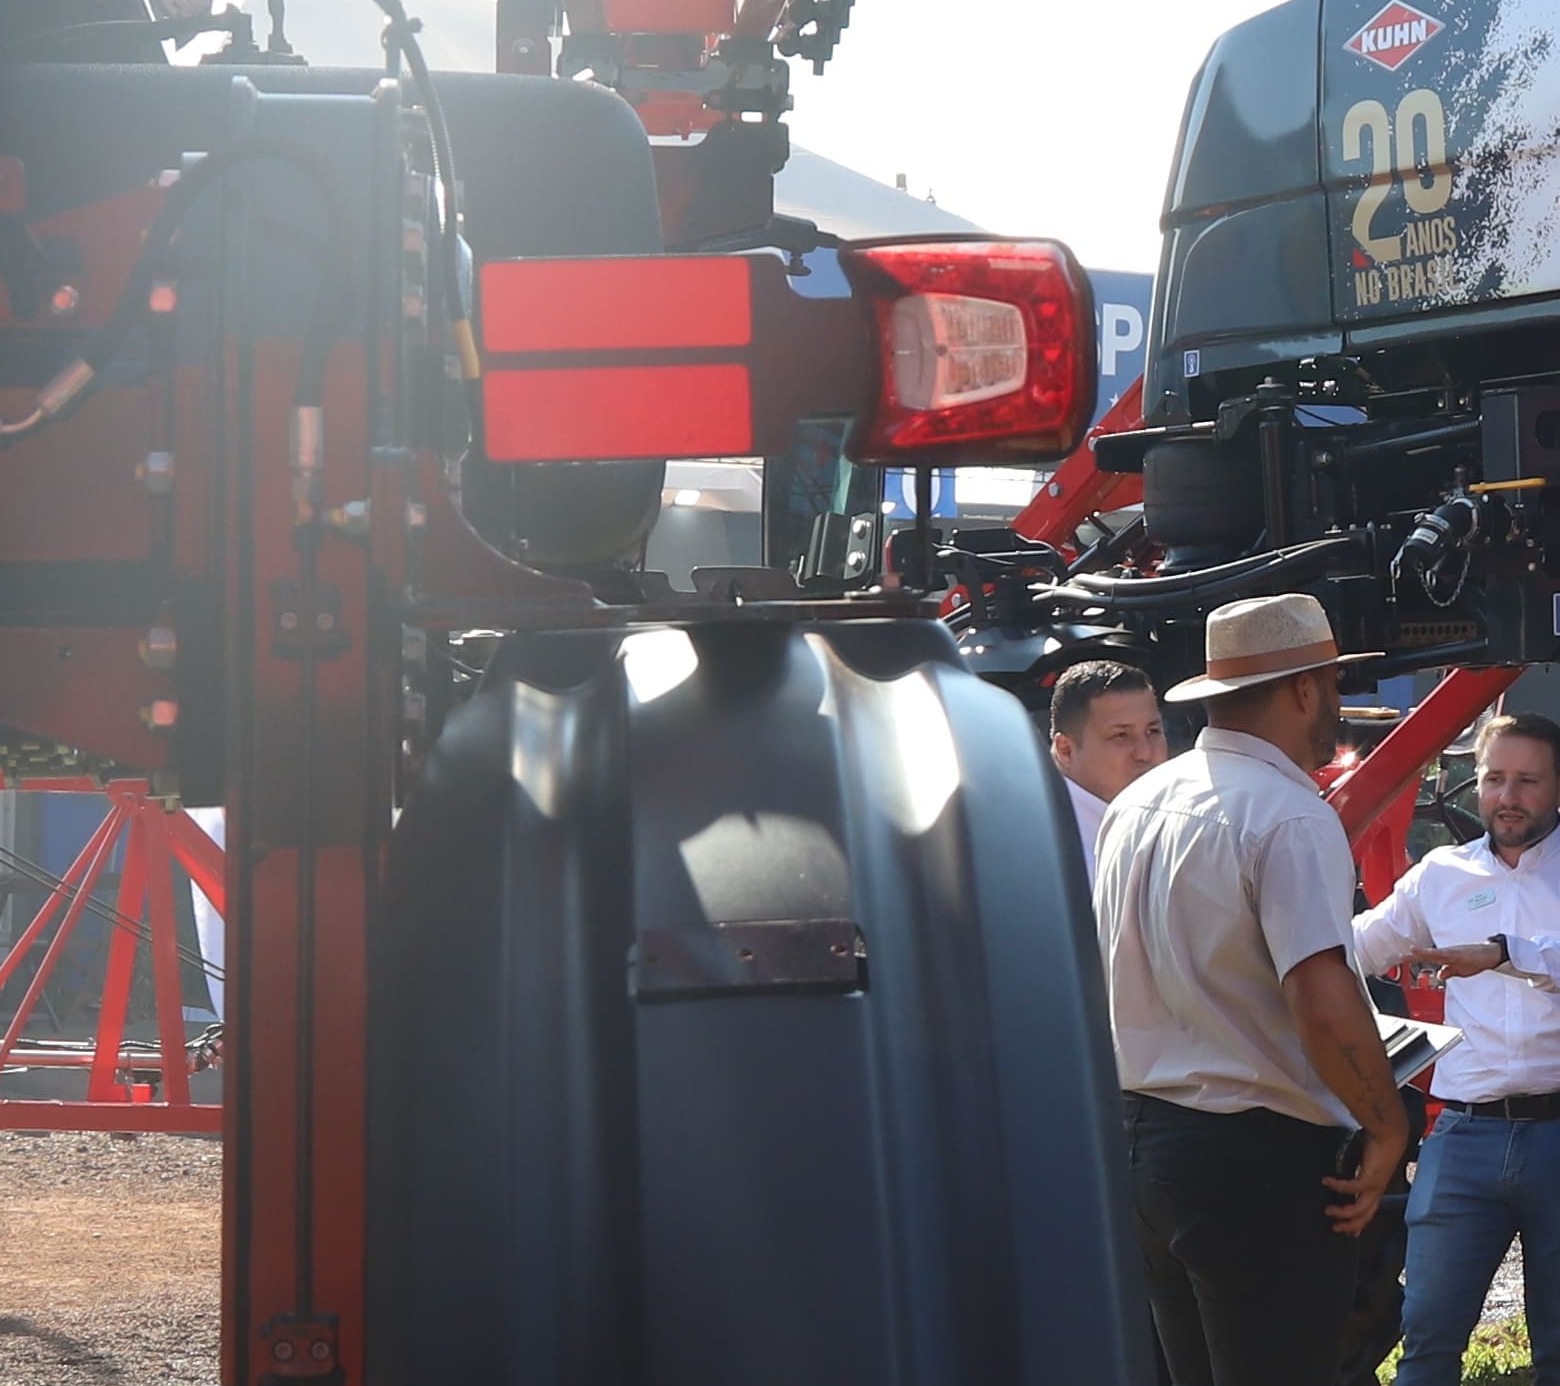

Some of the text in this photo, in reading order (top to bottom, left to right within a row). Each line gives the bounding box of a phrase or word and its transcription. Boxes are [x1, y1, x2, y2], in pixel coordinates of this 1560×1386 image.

[1361, 18, 1427, 54] KUHN
[1343, 88, 1453, 263] 20
[1406, 216, 1457, 257] ANOS
[1354, 256, 1461, 307] NO BRASIL
